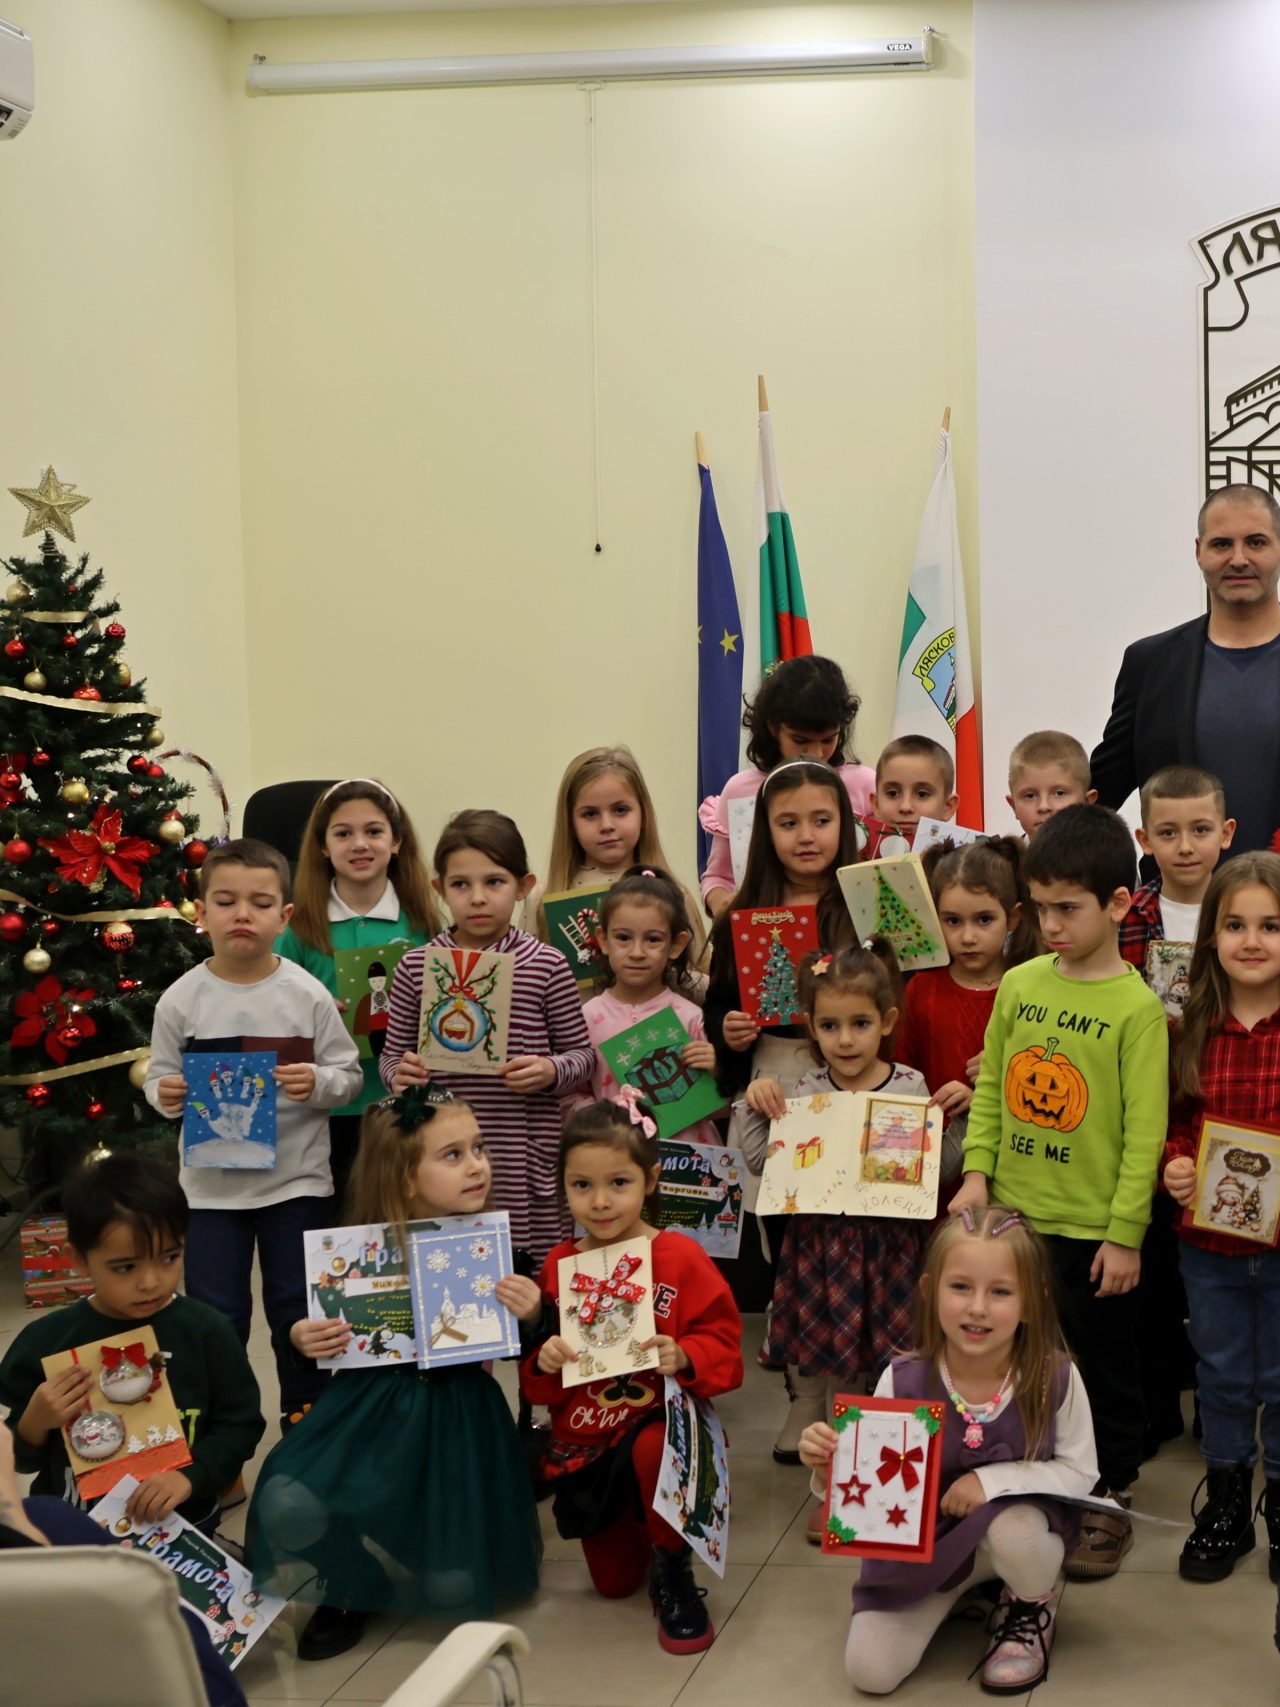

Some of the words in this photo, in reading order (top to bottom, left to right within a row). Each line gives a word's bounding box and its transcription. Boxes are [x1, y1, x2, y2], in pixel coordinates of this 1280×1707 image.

[1017, 1002, 1048, 1024] YOU
[1057, 1010, 1111, 1039] CAN'T
[1010, 1133, 1035, 1156] SEE
[1045, 1143, 1071, 1164] ME
[570, 1406, 596, 1430] Oh
[138, 1526, 236, 1604] Грамота
